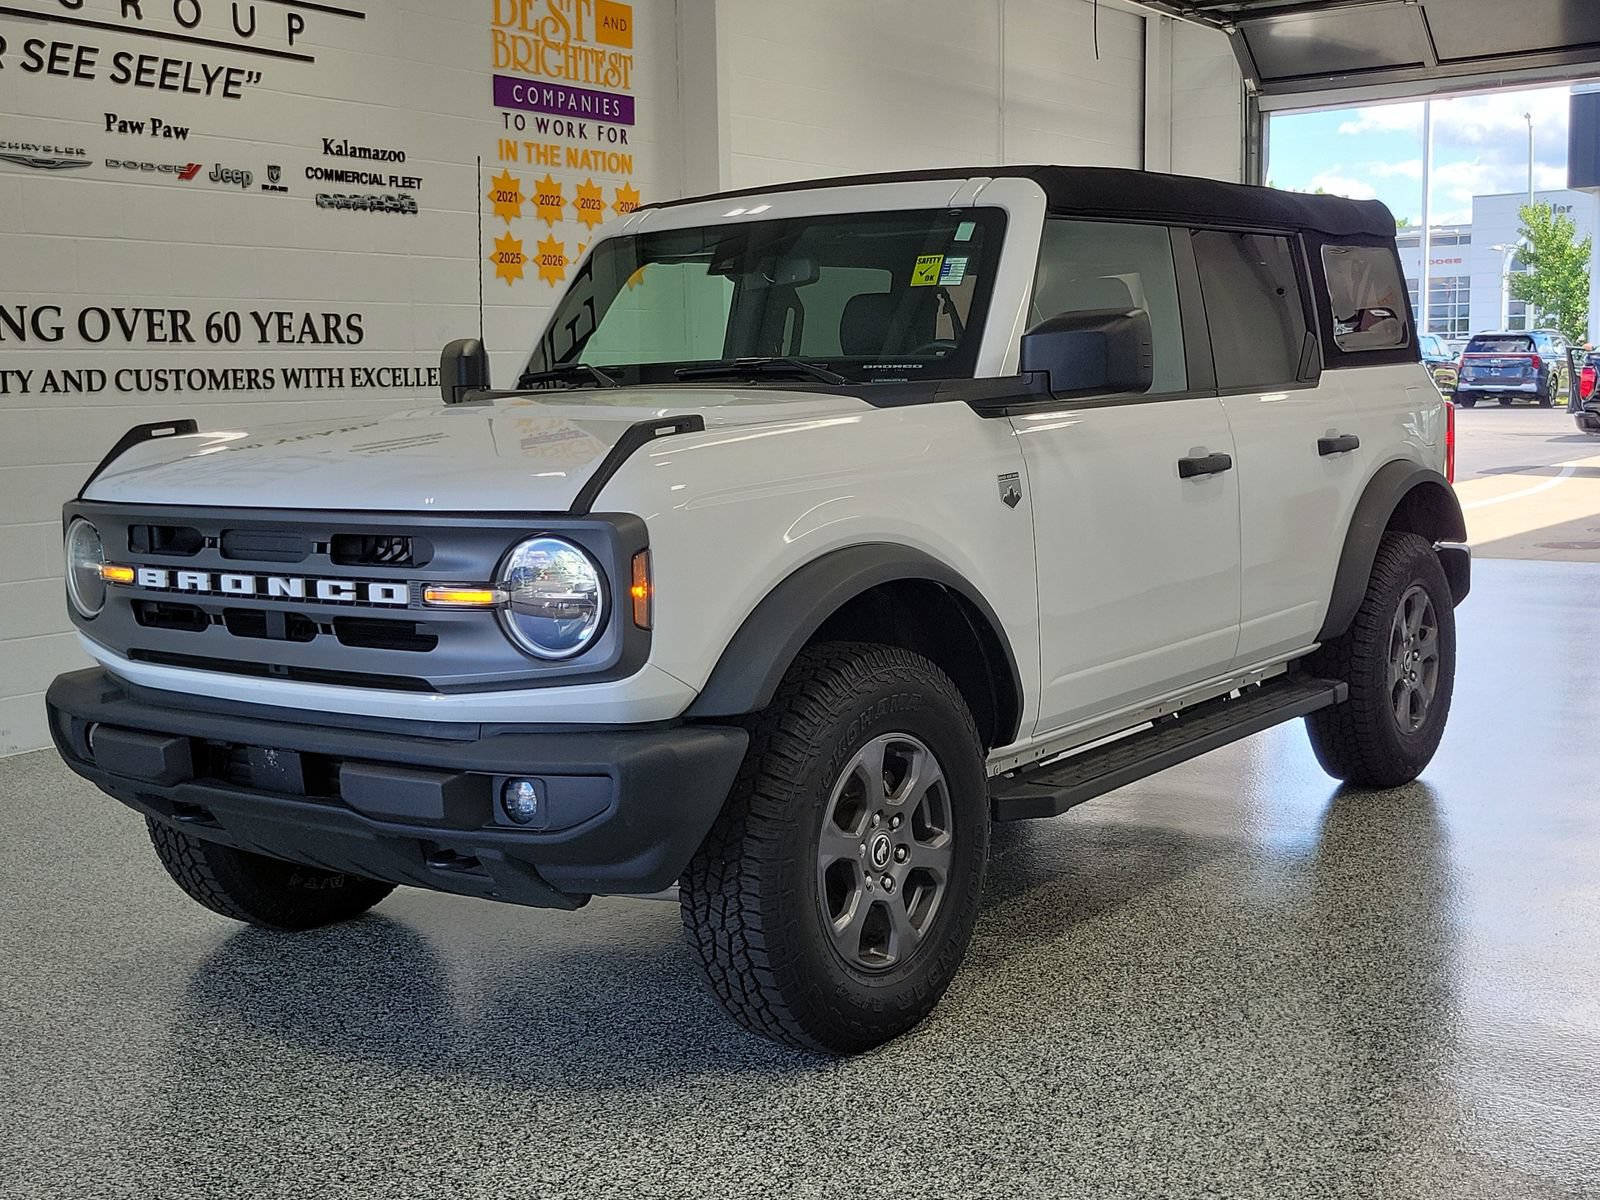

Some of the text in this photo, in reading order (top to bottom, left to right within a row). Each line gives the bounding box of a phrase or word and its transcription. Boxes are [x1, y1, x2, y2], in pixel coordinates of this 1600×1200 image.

[603, 16, 627, 31] AND
[20, 38, 100, 80] SEE
[491, 28, 633, 90] BRIGHTEST
[512, 84, 620, 117] COMPANIES
[104, 113, 190, 140] Paw Paw
[502, 112, 628, 145] TO WORK FOR
[322, 138, 406, 162] Kalamazoo
[498, 138, 633, 175] IN THE NATION
[105, 159, 192, 174] DODGE
[209, 163, 253, 188] Jeep
[305, 166, 423, 190] COMMERCIAL FLEET
[496, 190, 518, 203] 2021
[539, 194, 561, 207] 2022
[580, 198, 600, 210] 2023
[498, 251, 521, 264] 2025
[541, 254, 563, 267] 2026
[917, 256, 941, 265] SAFETY
[78, 307, 196, 343] OVER
[205, 311, 241, 343] 60
[250, 311, 364, 344] YEARS
[40, 369, 107, 393] AND
[114, 367, 275, 393] CUSTOMERS
[281, 367, 345, 389] WITH
[350, 366, 441, 388] EXCELLE
[137, 567, 410, 606] BRONCO
